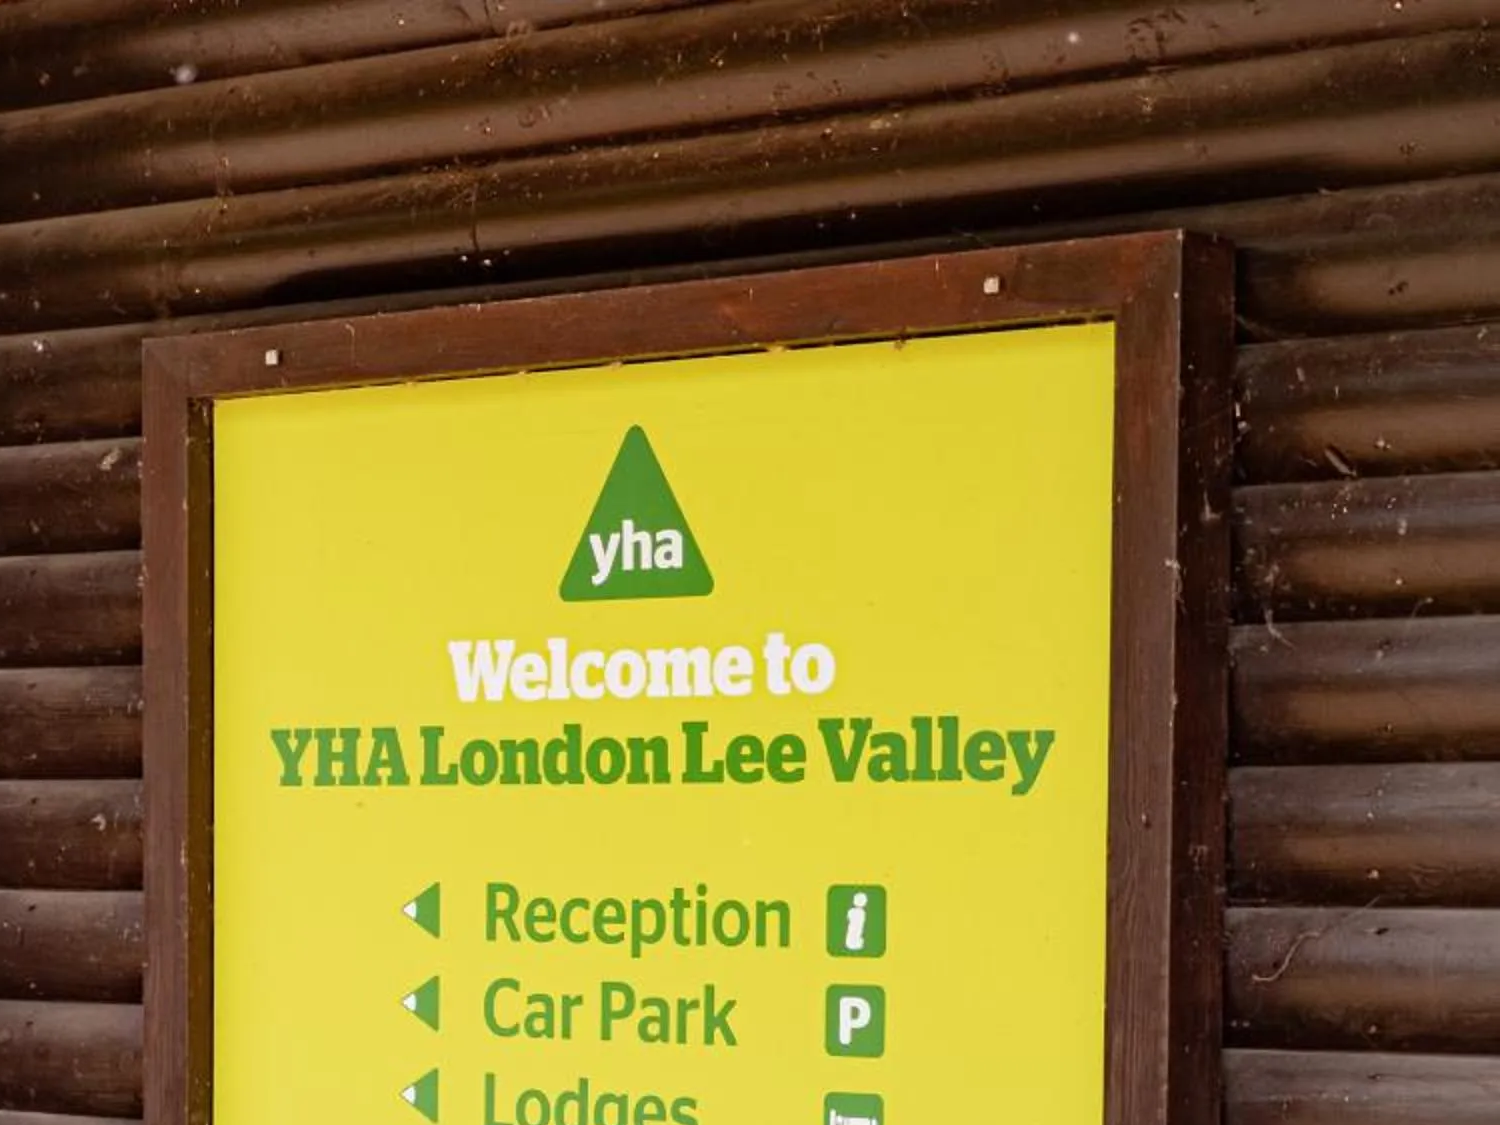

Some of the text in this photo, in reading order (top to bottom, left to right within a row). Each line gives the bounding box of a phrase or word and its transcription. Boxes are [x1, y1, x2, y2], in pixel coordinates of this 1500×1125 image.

[589, 520, 683, 585] yha
[448, 633, 836, 702] Welcome to
[270, 716, 1056, 796] YHA London Lee Valley
[485, 882, 791, 958] Reception
[483, 977, 738, 1046] Car Park
[838, 996, 871, 1045] P
